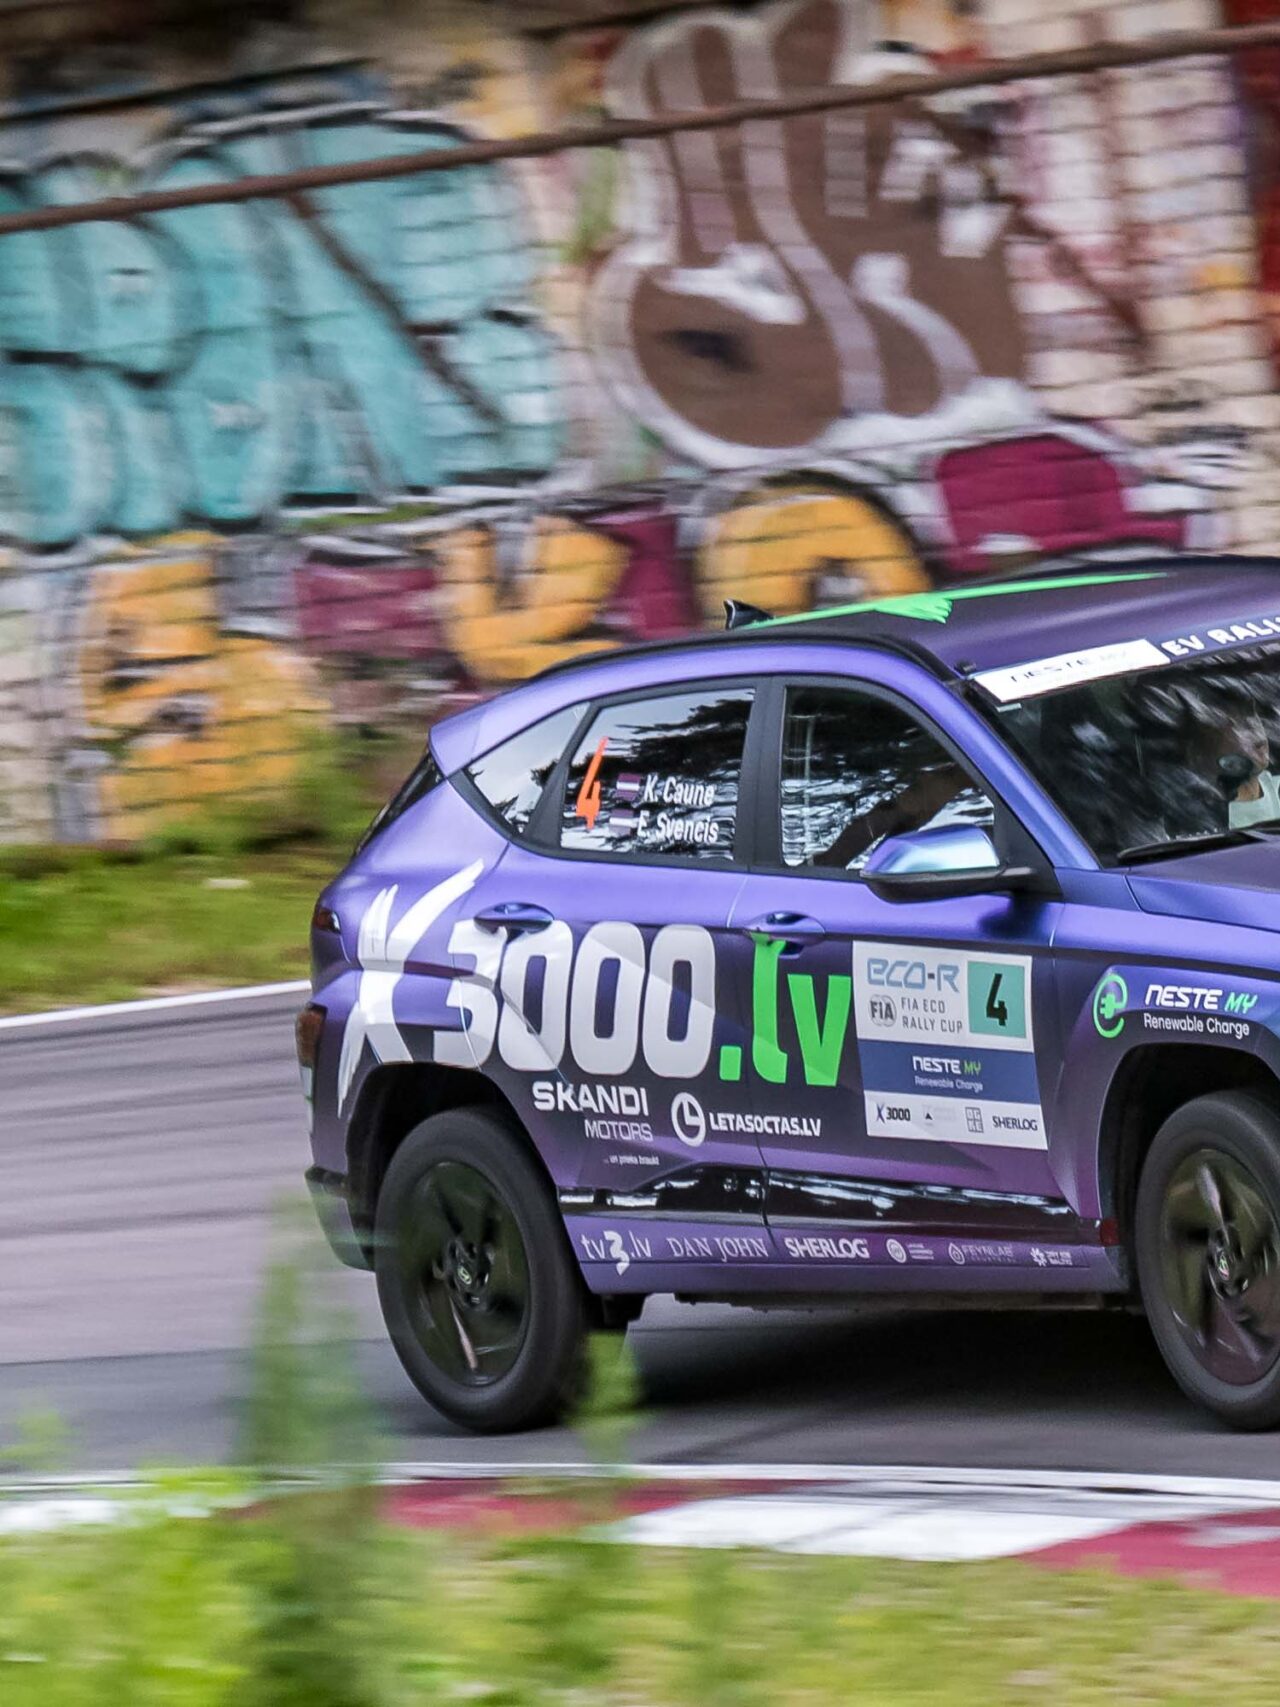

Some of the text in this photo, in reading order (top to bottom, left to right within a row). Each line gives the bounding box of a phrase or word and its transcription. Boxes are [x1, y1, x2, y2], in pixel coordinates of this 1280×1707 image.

[1161, 635, 1205, 656] EV
[575, 736, 609, 829] 4
[644, 774, 715, 806] K. Caune
[656, 813, 719, 843] Svencis
[869, 1000, 896, 1021] FIA
[901, 997, 945, 1014] FIA ECO
[986, 973, 1008, 1026] 4
[1145, 984, 1258, 1014] NESTE MY
[902, 1015, 963, 1034] RALLY CUP
[1144, 1013, 1250, 1039] Renewable Charge
[912, 1056, 981, 1075] NESTE MY
[915, 1075, 983, 1093] Renewable Charge
[532, 1081, 649, 1116] SKANDI
[584, 1119, 653, 1141] MOTORS
[709, 1112, 821, 1137] LETASOCTAS.LV
[992, 1115, 1038, 1131] SHERLOG
[666, 1236, 769, 1262] DAN JOHN
[784, 1237, 870, 1258] SHERLOG
